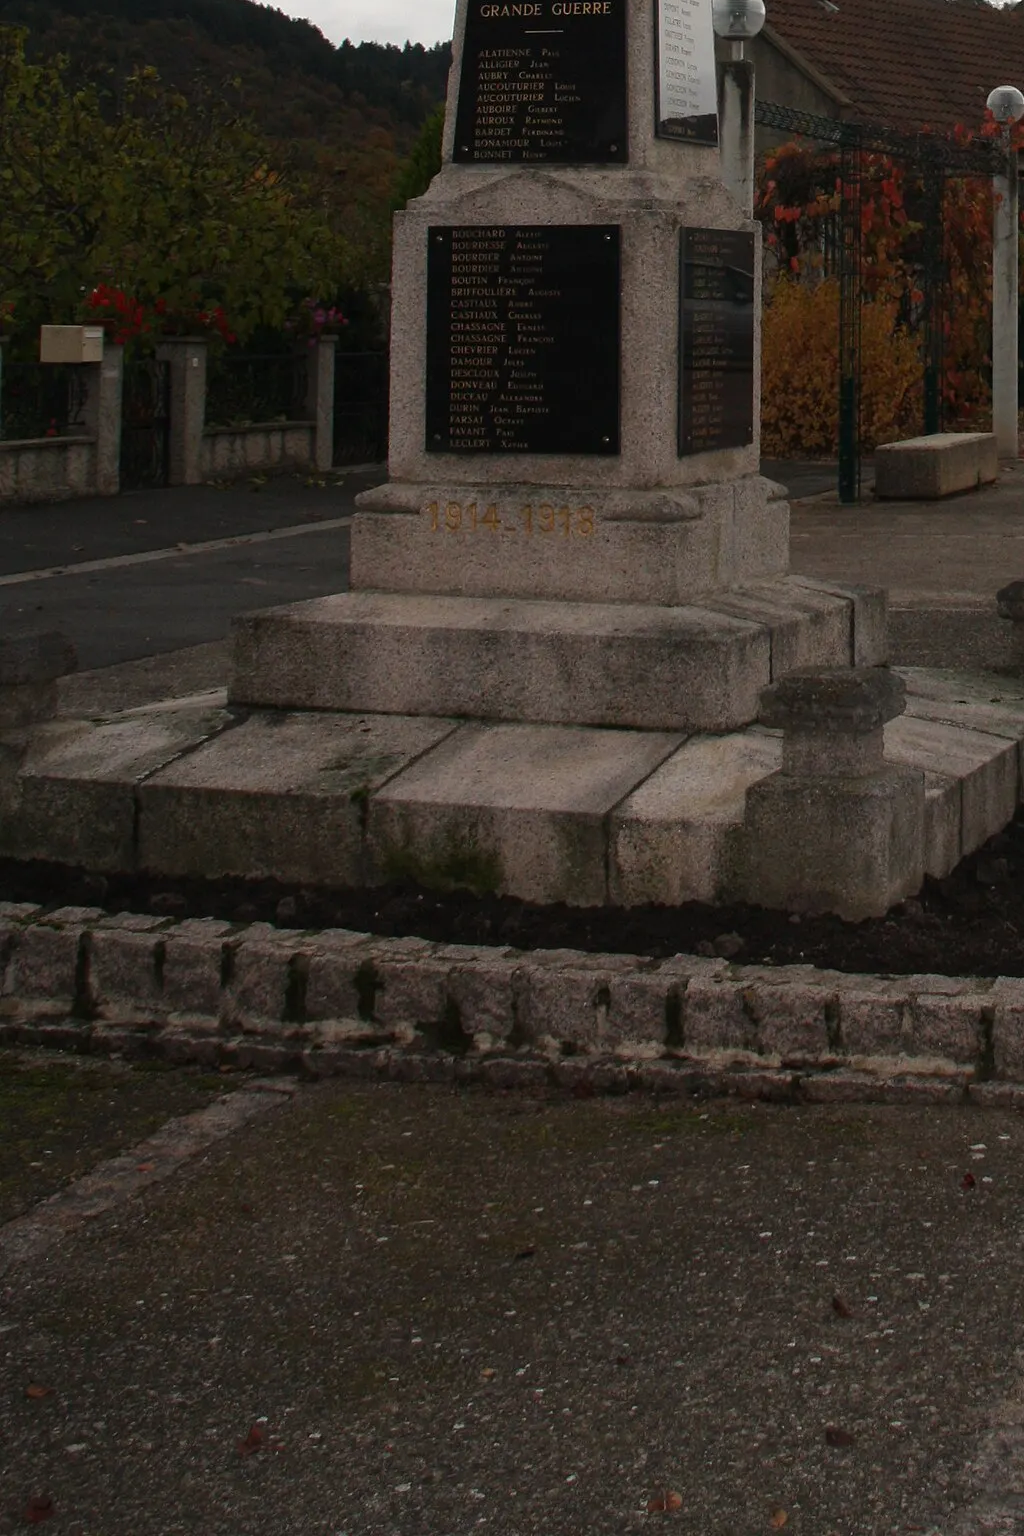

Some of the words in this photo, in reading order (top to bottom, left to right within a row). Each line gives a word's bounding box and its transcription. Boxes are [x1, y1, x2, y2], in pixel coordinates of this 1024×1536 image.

[480, 3, 542, 17] GRANDE
[552, 1, 611, 15] GUERRE
[478, 71, 509, 80] AUBRY
[478, 83, 544, 91] AUCOUTURIER
[477, 94, 544, 102] AUCOUTURIER
[476, 105, 517, 113] AUBOIRE
[475, 128, 512, 136] BARDET
[474, 139, 529, 147] BONAMOUR
[451, 276, 488, 284] BOUTIN
[450, 323, 506, 331] CHASSAGNE
[451, 334, 507, 342] CHASSAGNE
